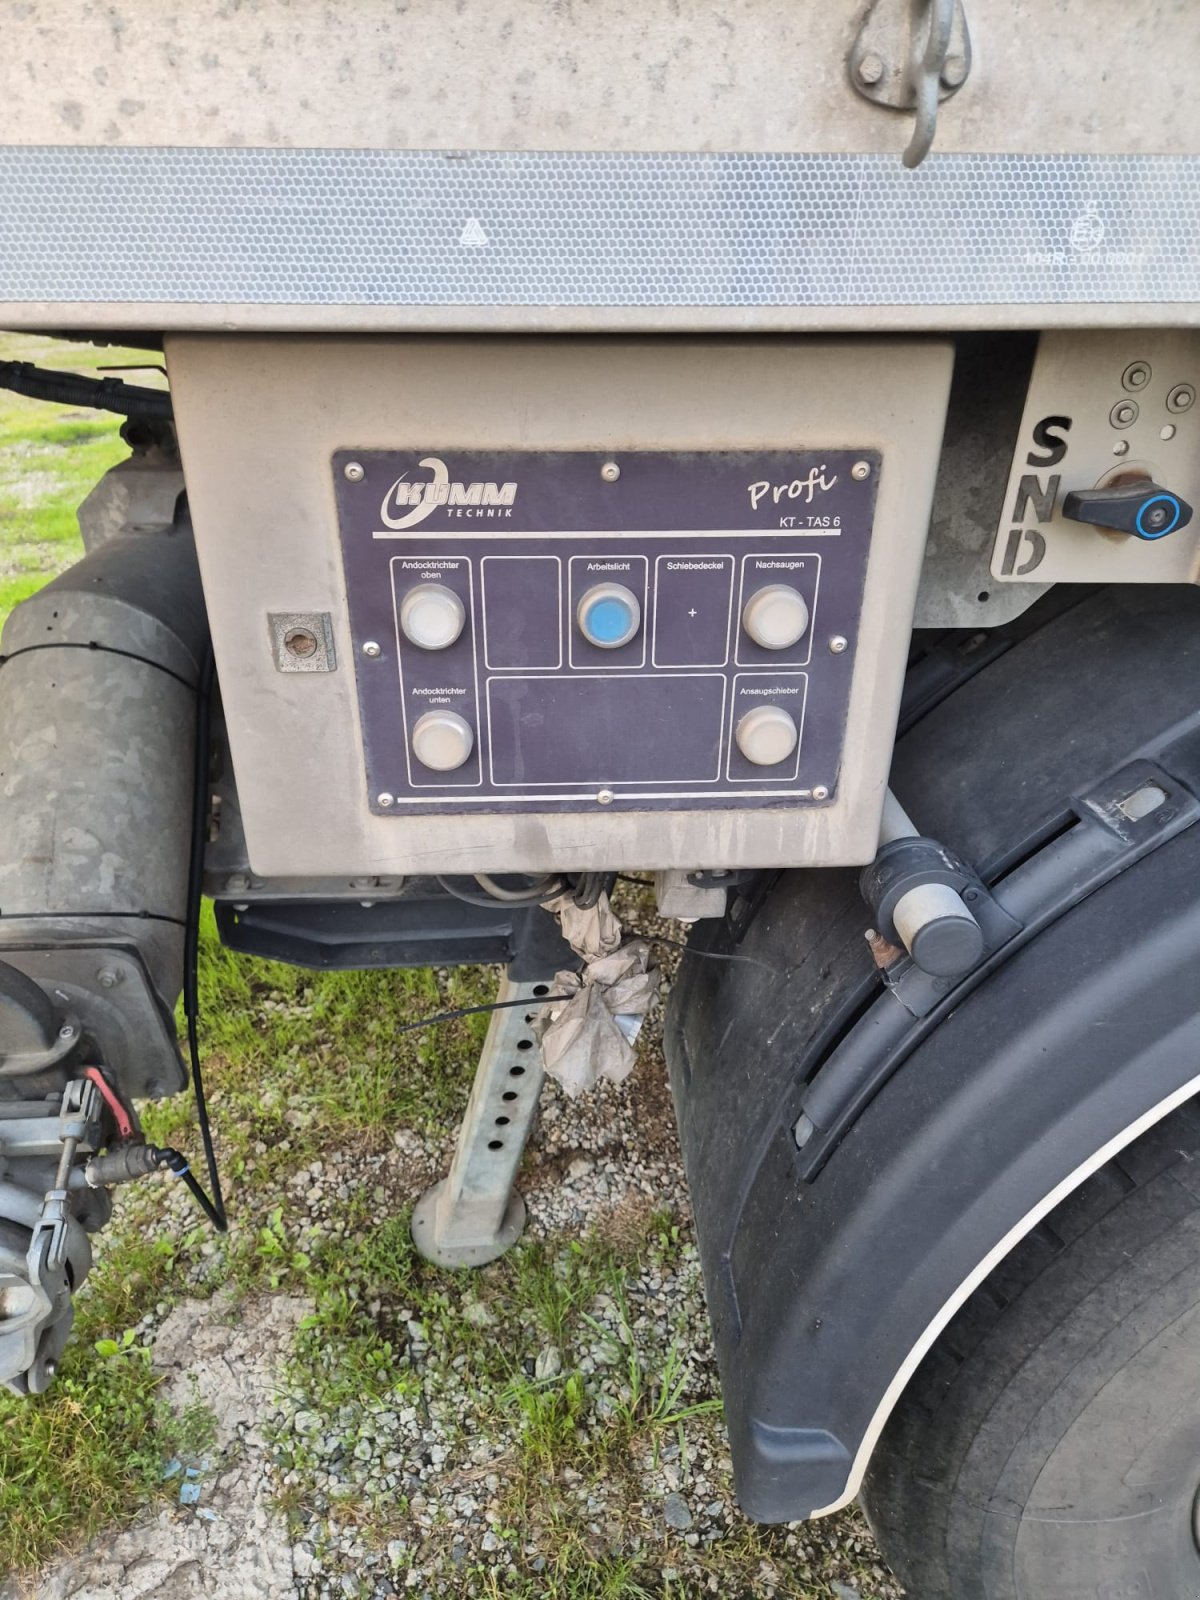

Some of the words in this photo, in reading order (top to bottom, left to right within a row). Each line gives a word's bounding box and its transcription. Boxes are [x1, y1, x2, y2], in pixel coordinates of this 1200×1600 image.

[1026, 415, 1073, 468] S
[748, 464, 837, 510] Profi
[1012, 474, 1062, 523] N
[447, 508, 513, 518] TECHNIK
[779, 517, 796, 528] KT
[807, 517, 831, 528] TAS
[833, 516, 841, 527] 6
[1001, 529, 1046, 576] D
[401, 560, 460, 571] Andocktrichter
[587, 562, 631, 571] Arbeitslicht
[666, 561, 724, 571] Schiebedeckel
[755, 560, 805, 571] Nachsaugen
[420, 571, 442, 579] oben
[412, 687, 467, 696] Andocktrichter
[740, 686, 799, 696] Ansaugschieber
[429, 696, 451, 704] unten
